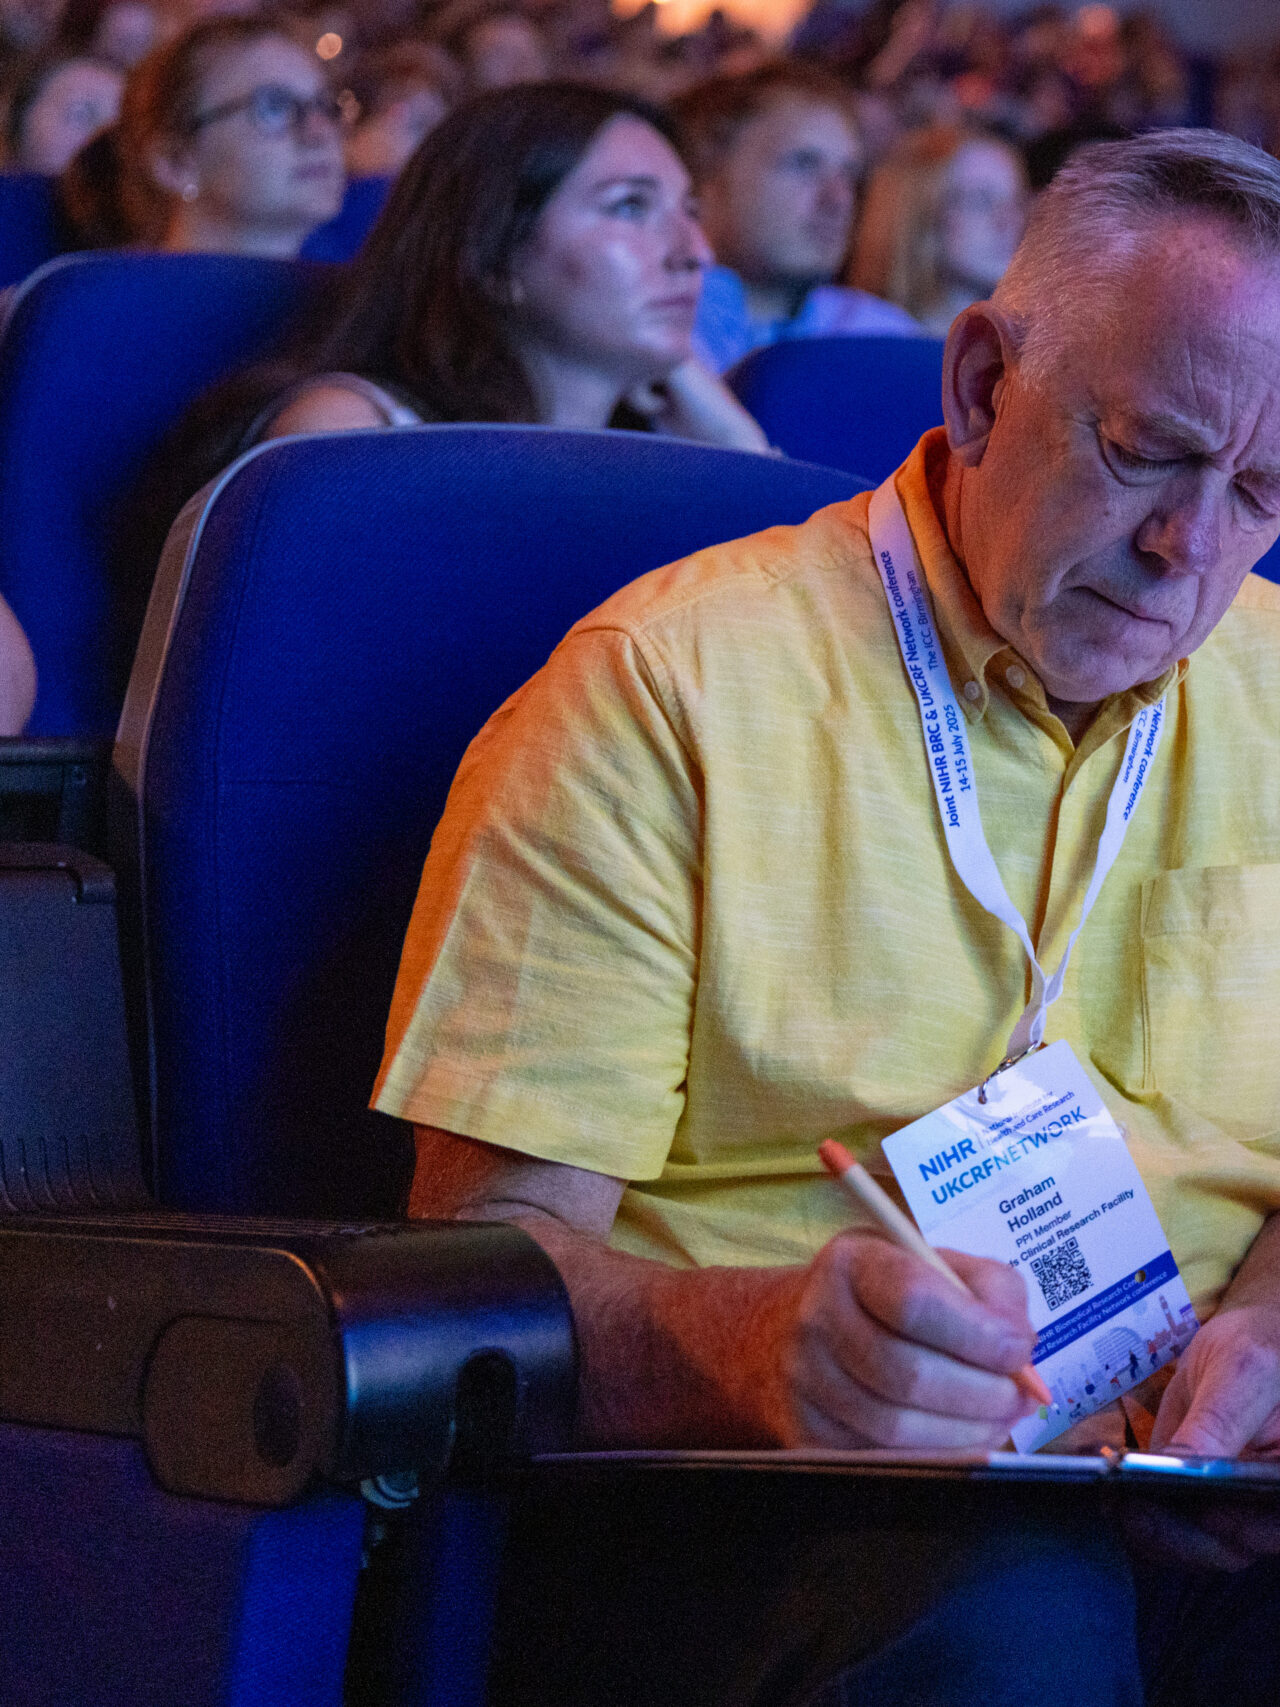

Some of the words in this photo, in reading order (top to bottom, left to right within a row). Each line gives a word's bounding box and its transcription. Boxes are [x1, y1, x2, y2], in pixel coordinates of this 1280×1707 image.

[881, 550, 905, 607] conference
[907, 570, 929, 625] Birmingham
[897, 608, 919, 662] Network
[928, 650, 938, 671] The
[910, 663, 934, 707] UKCRF
[925, 708, 938, 720] &
[943, 704, 960, 733] 2025
[1144, 708, 1162, 758] Network
[927, 722, 944, 753] BRC
[952, 734, 964, 756] July
[935, 755, 951, 793] NIHR
[954, 759, 971, 792] 14-15
[1123, 757, 1148, 821] conference
[944, 795, 960, 828] Joint
[1025, 1110, 1044, 1123] Care
[1042, 1091, 1075, 1113] Research
[918, 1137, 978, 1182] NIHR
[999, 1176, 1056, 1214] Graham
[1007, 1191, 1063, 1232] Holland
[1015, 1232, 1034, 1248] PPI
[1033, 1210, 1072, 1238] Member
[1020, 1235, 1056, 1261] Clinical
[1056, 1208, 1101, 1240] Research
[1100, 1188, 1134, 1213] Facility
[1046, 1328, 1079, 1349] Research
[1077, 1313, 1102, 1332] Facility
[1101, 1294, 1132, 1316] Network
[1054, 1305, 1093, 1334] Biomedical
[1091, 1287, 1123, 1310] Research
